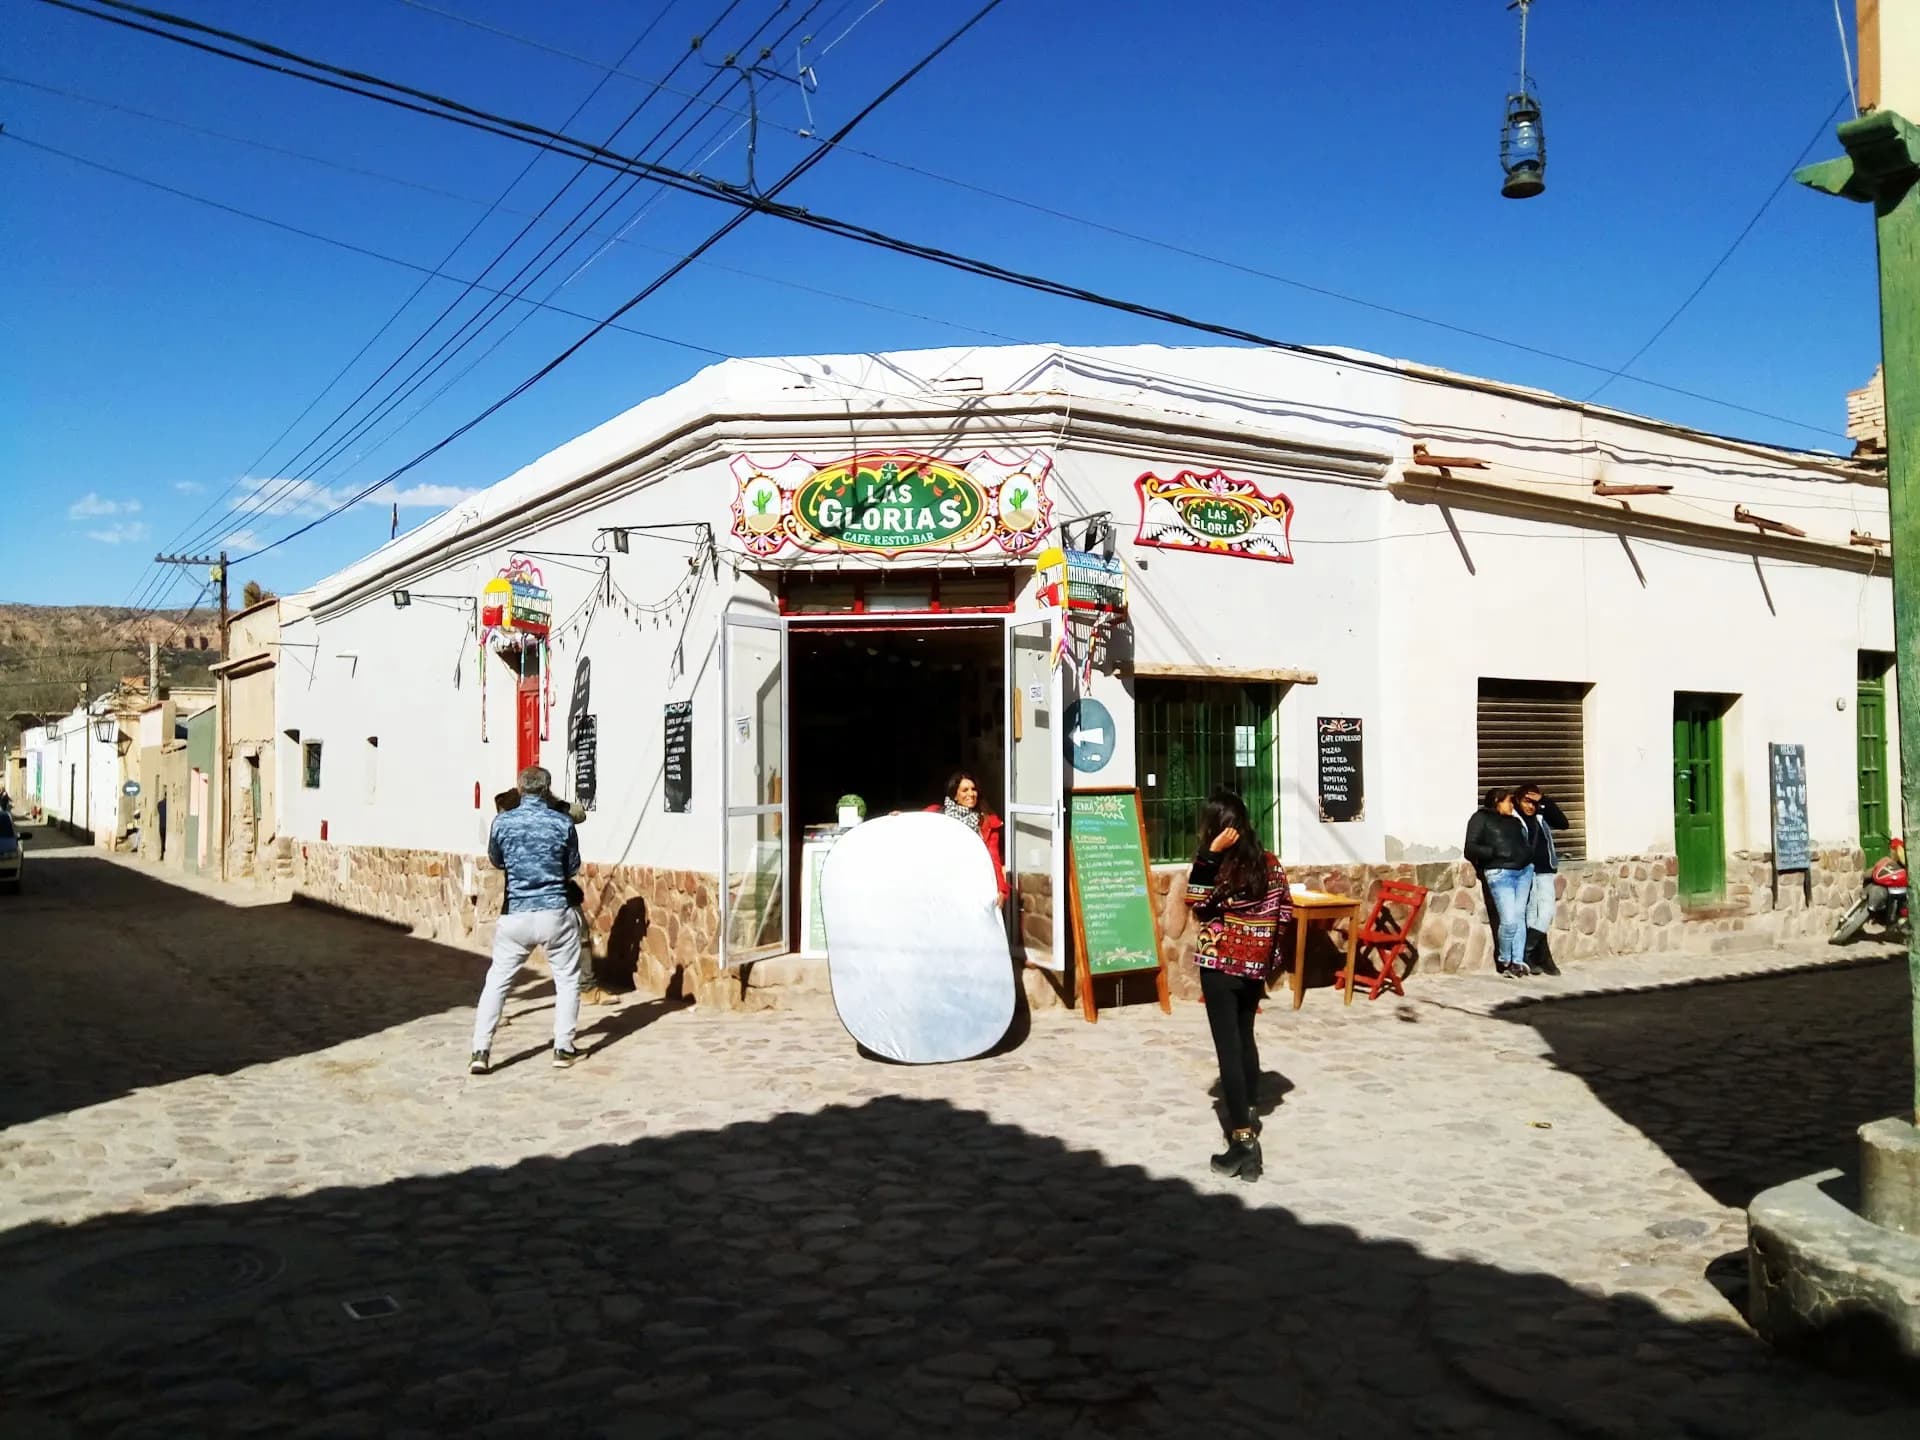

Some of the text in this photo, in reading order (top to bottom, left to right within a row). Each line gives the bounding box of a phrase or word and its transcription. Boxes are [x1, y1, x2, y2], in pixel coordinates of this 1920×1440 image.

[867, 484, 912, 503] LAS
[819, 498, 961, 532] GLORIAS
[1190, 513, 1245, 535] GLORIAS
[1207, 508, 1227, 520] LAS
